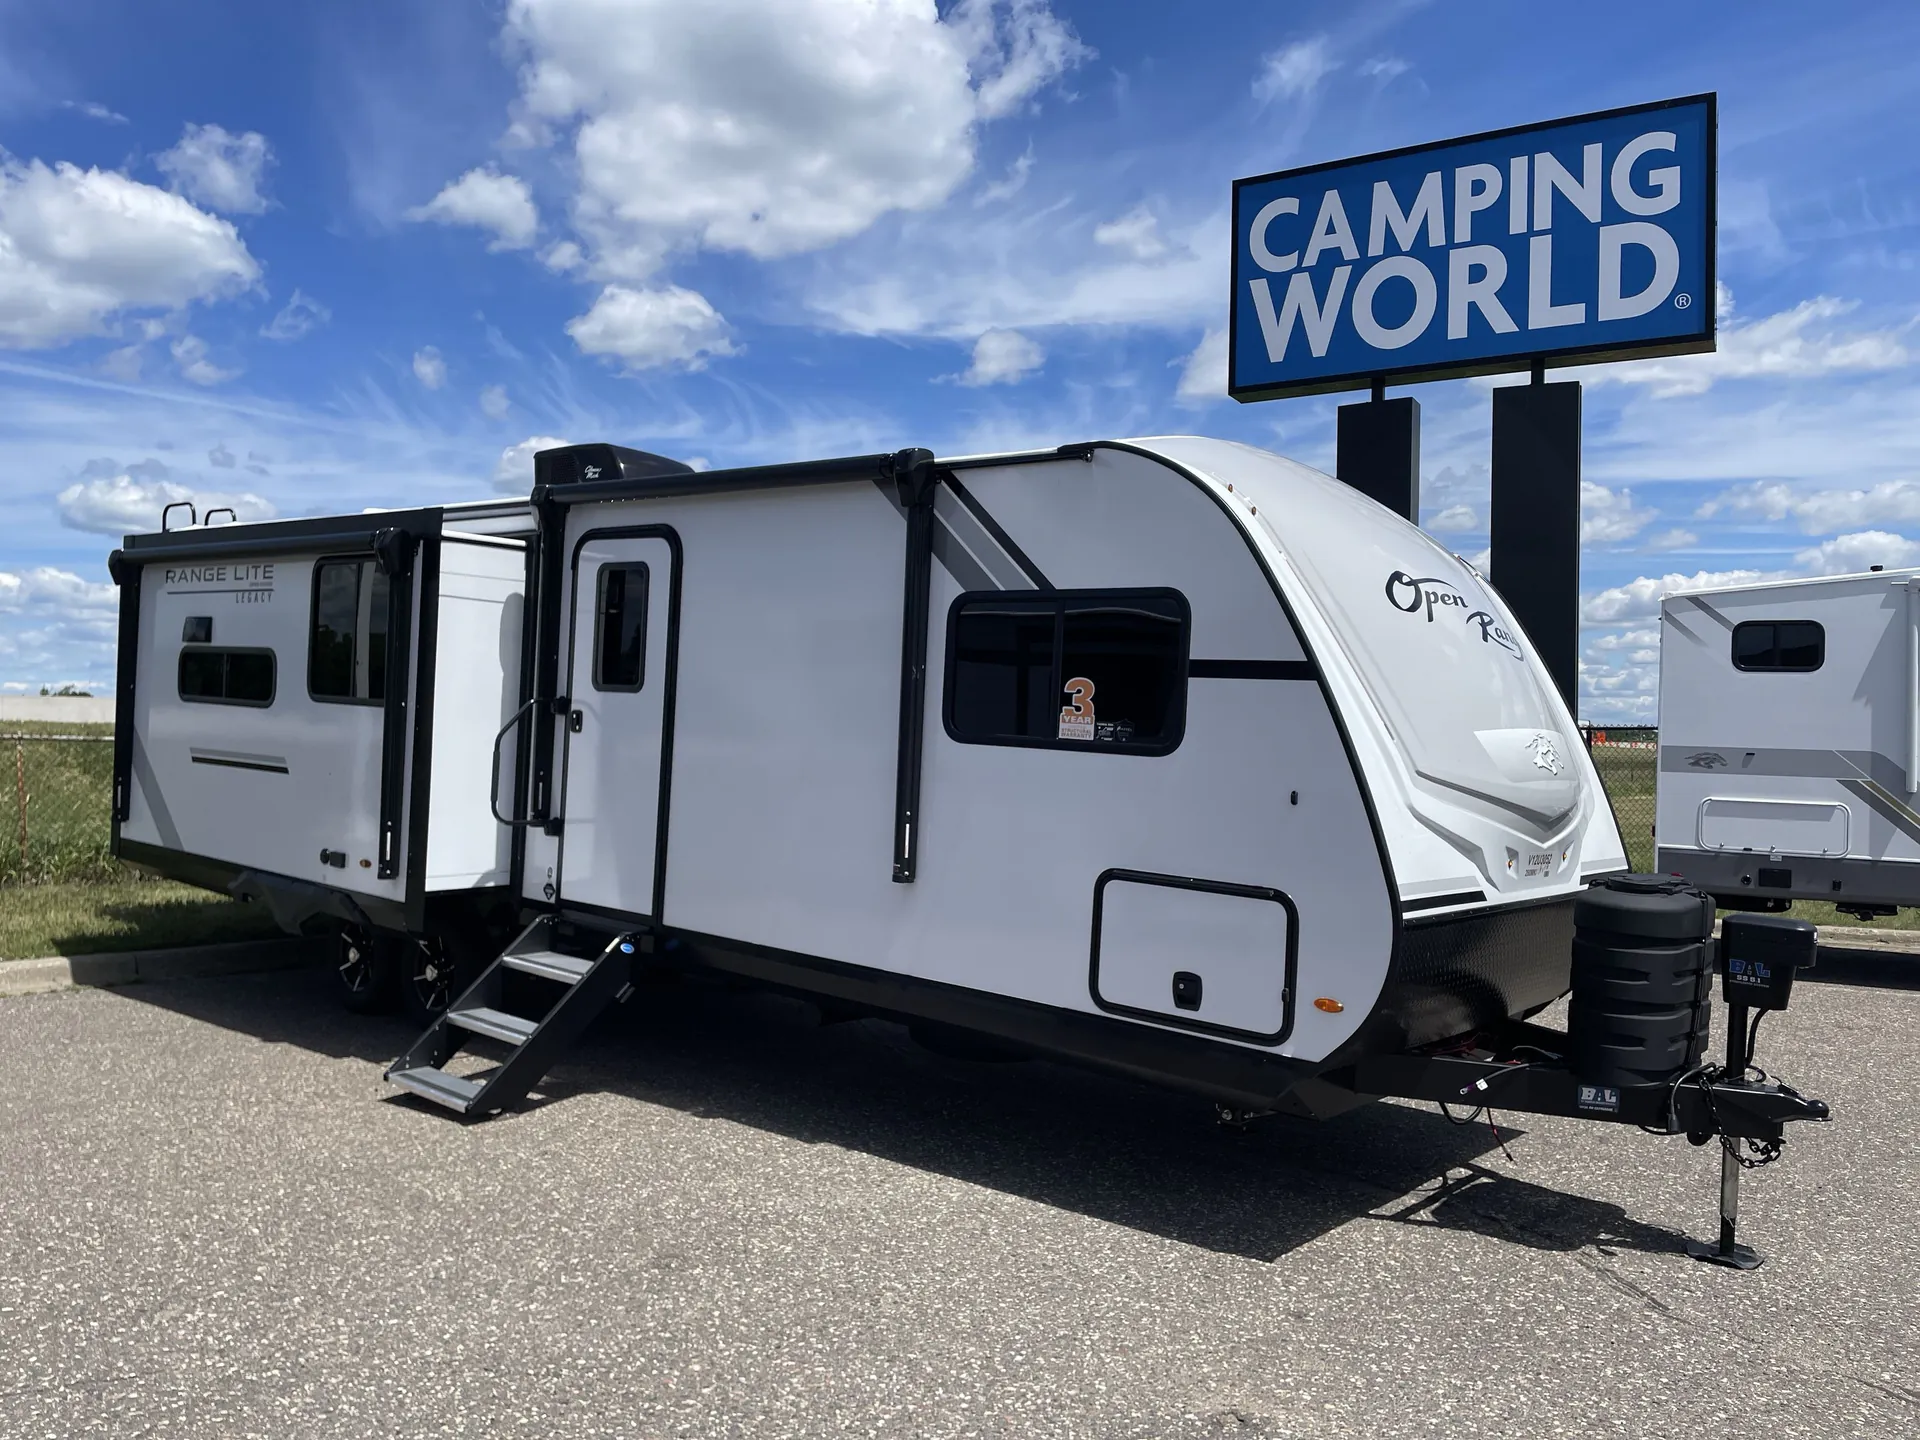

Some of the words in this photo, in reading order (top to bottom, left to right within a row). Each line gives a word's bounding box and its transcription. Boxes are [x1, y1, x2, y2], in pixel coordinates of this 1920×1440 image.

[1249, 131, 1681, 273] CAMPING
[1249, 221, 1681, 363] WORLD
[165, 566, 227, 584] RANGE
[234, 564, 274, 580] LITE
[1385, 570, 1469, 623] Open
[235, 592, 272, 604] LEGACY
[1466, 611, 1525, 662] Rang
[1062, 677, 1095, 716] 3
[1063, 715, 1092, 724] YEAR
